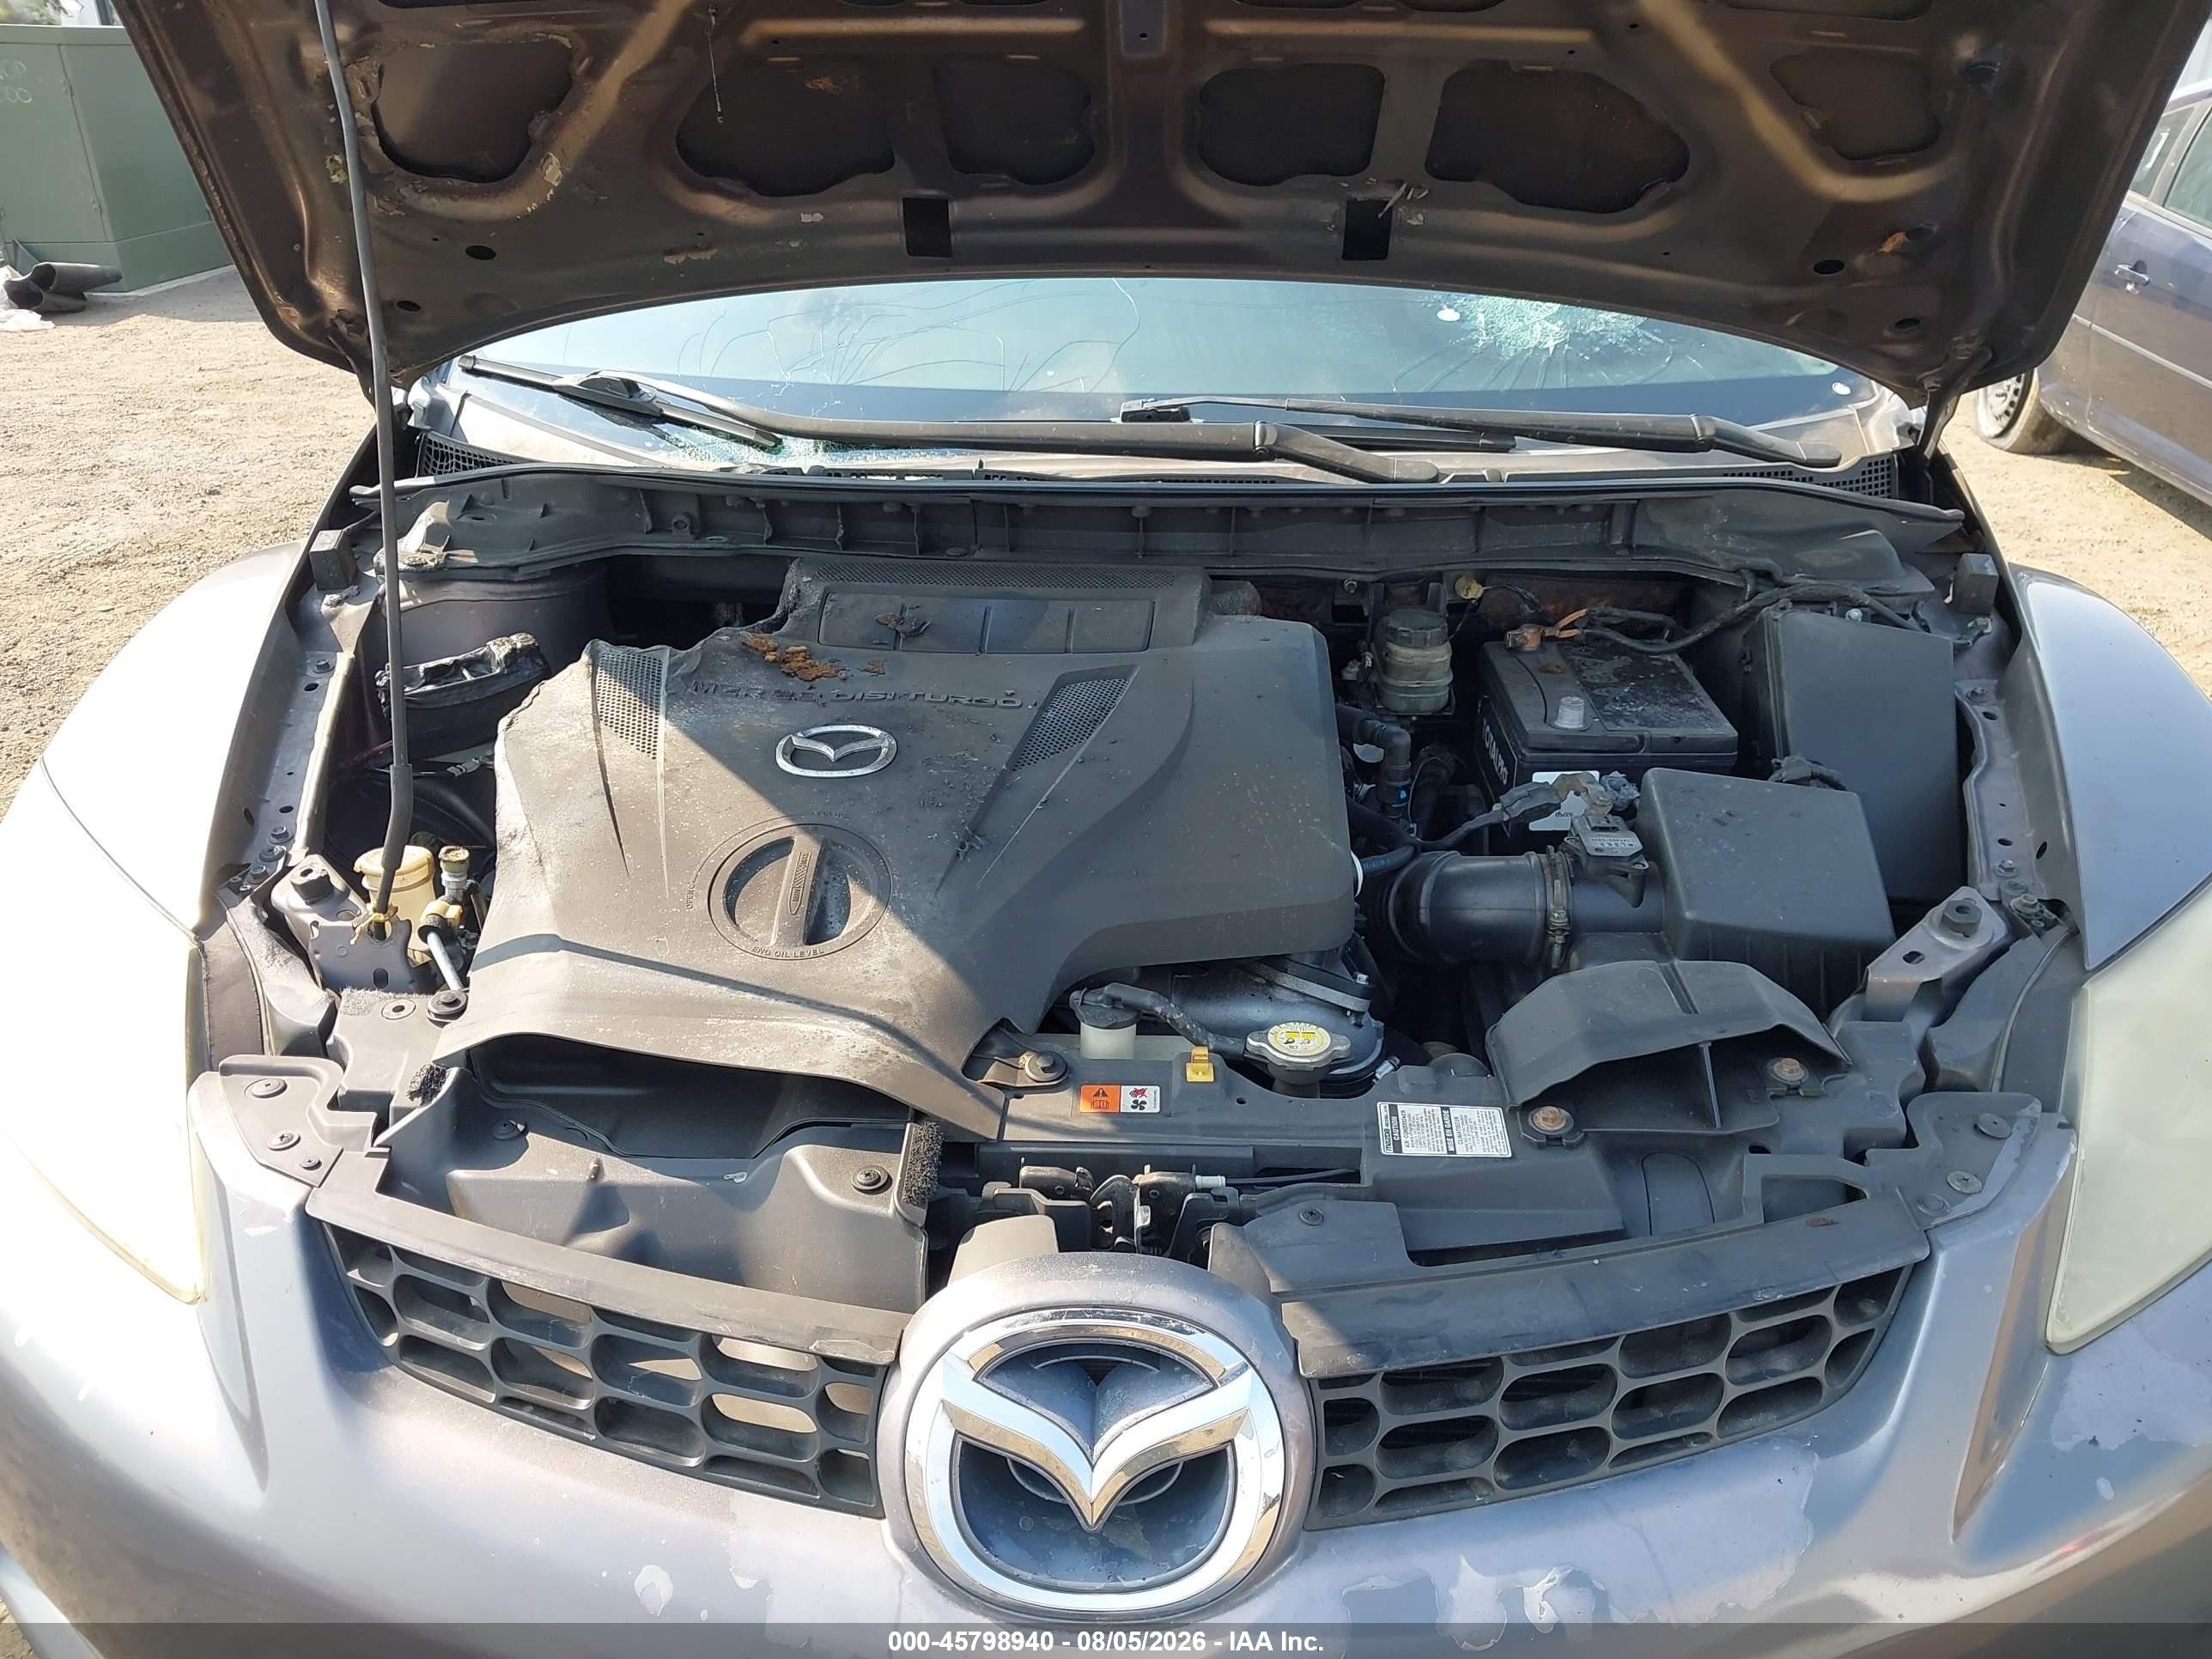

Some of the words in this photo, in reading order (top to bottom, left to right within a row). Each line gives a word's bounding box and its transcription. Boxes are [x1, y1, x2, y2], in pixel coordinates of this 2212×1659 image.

[906, 690, 1023, 709] TURBO
[751, 946, 771, 956] ENG
[793, 947, 824, 958] LEVEL
[1442, 1109, 1451, 1128] GARDE
[1391, 1116, 1400, 1141] CAUTION
[1447, 1137, 1455, 1152] MISE
